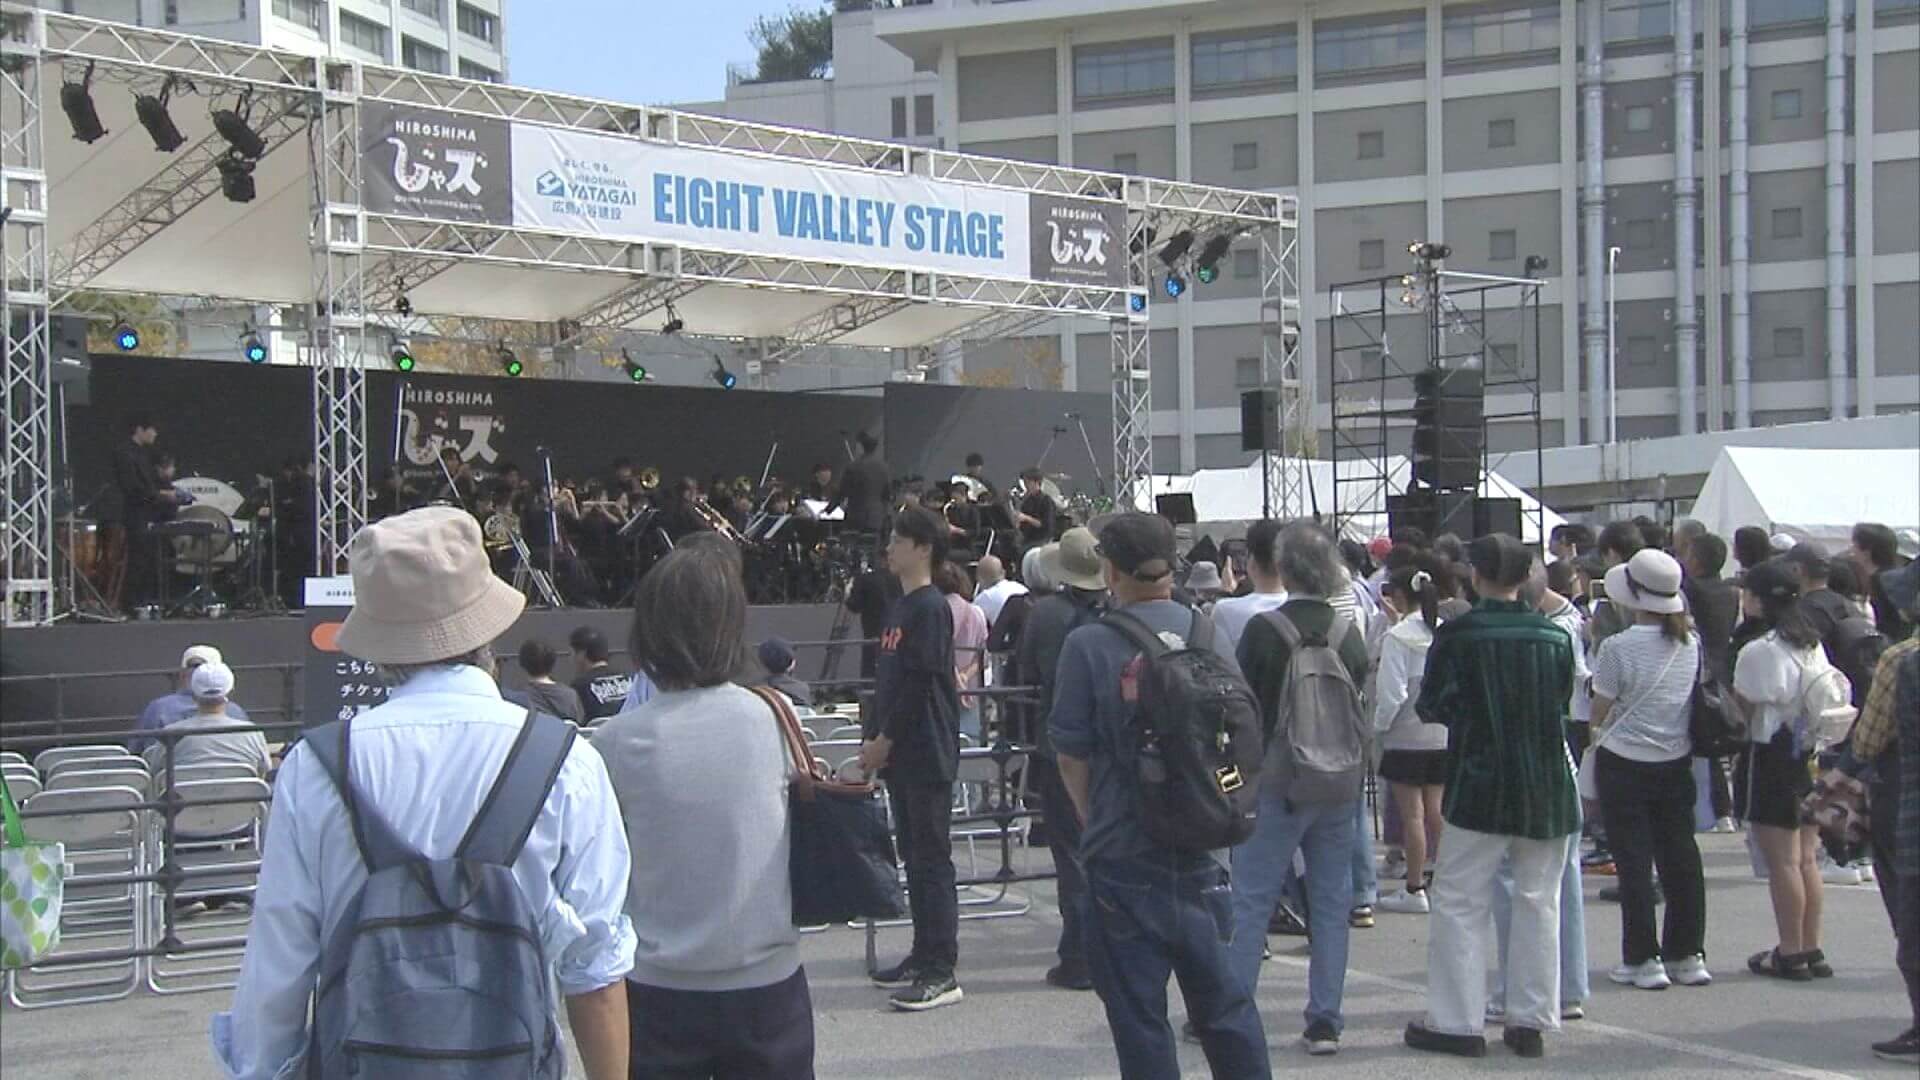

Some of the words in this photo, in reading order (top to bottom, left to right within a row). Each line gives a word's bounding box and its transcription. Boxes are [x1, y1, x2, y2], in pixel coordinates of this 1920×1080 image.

[395, 120, 477, 142] HIROSHIMA
[386, 136, 489, 196] じゃズ
[568, 184, 637, 206] YATAGAI
[653, 172, 764, 233] EIGHT
[772, 187, 896, 249] VALLEY
[904, 204, 1004, 259] STAGE
[1051, 207, 1103, 222] HIROSHIMA
[404, 389, 494, 406] HIROSHIMA
[335, 660, 376, 675] こちら
